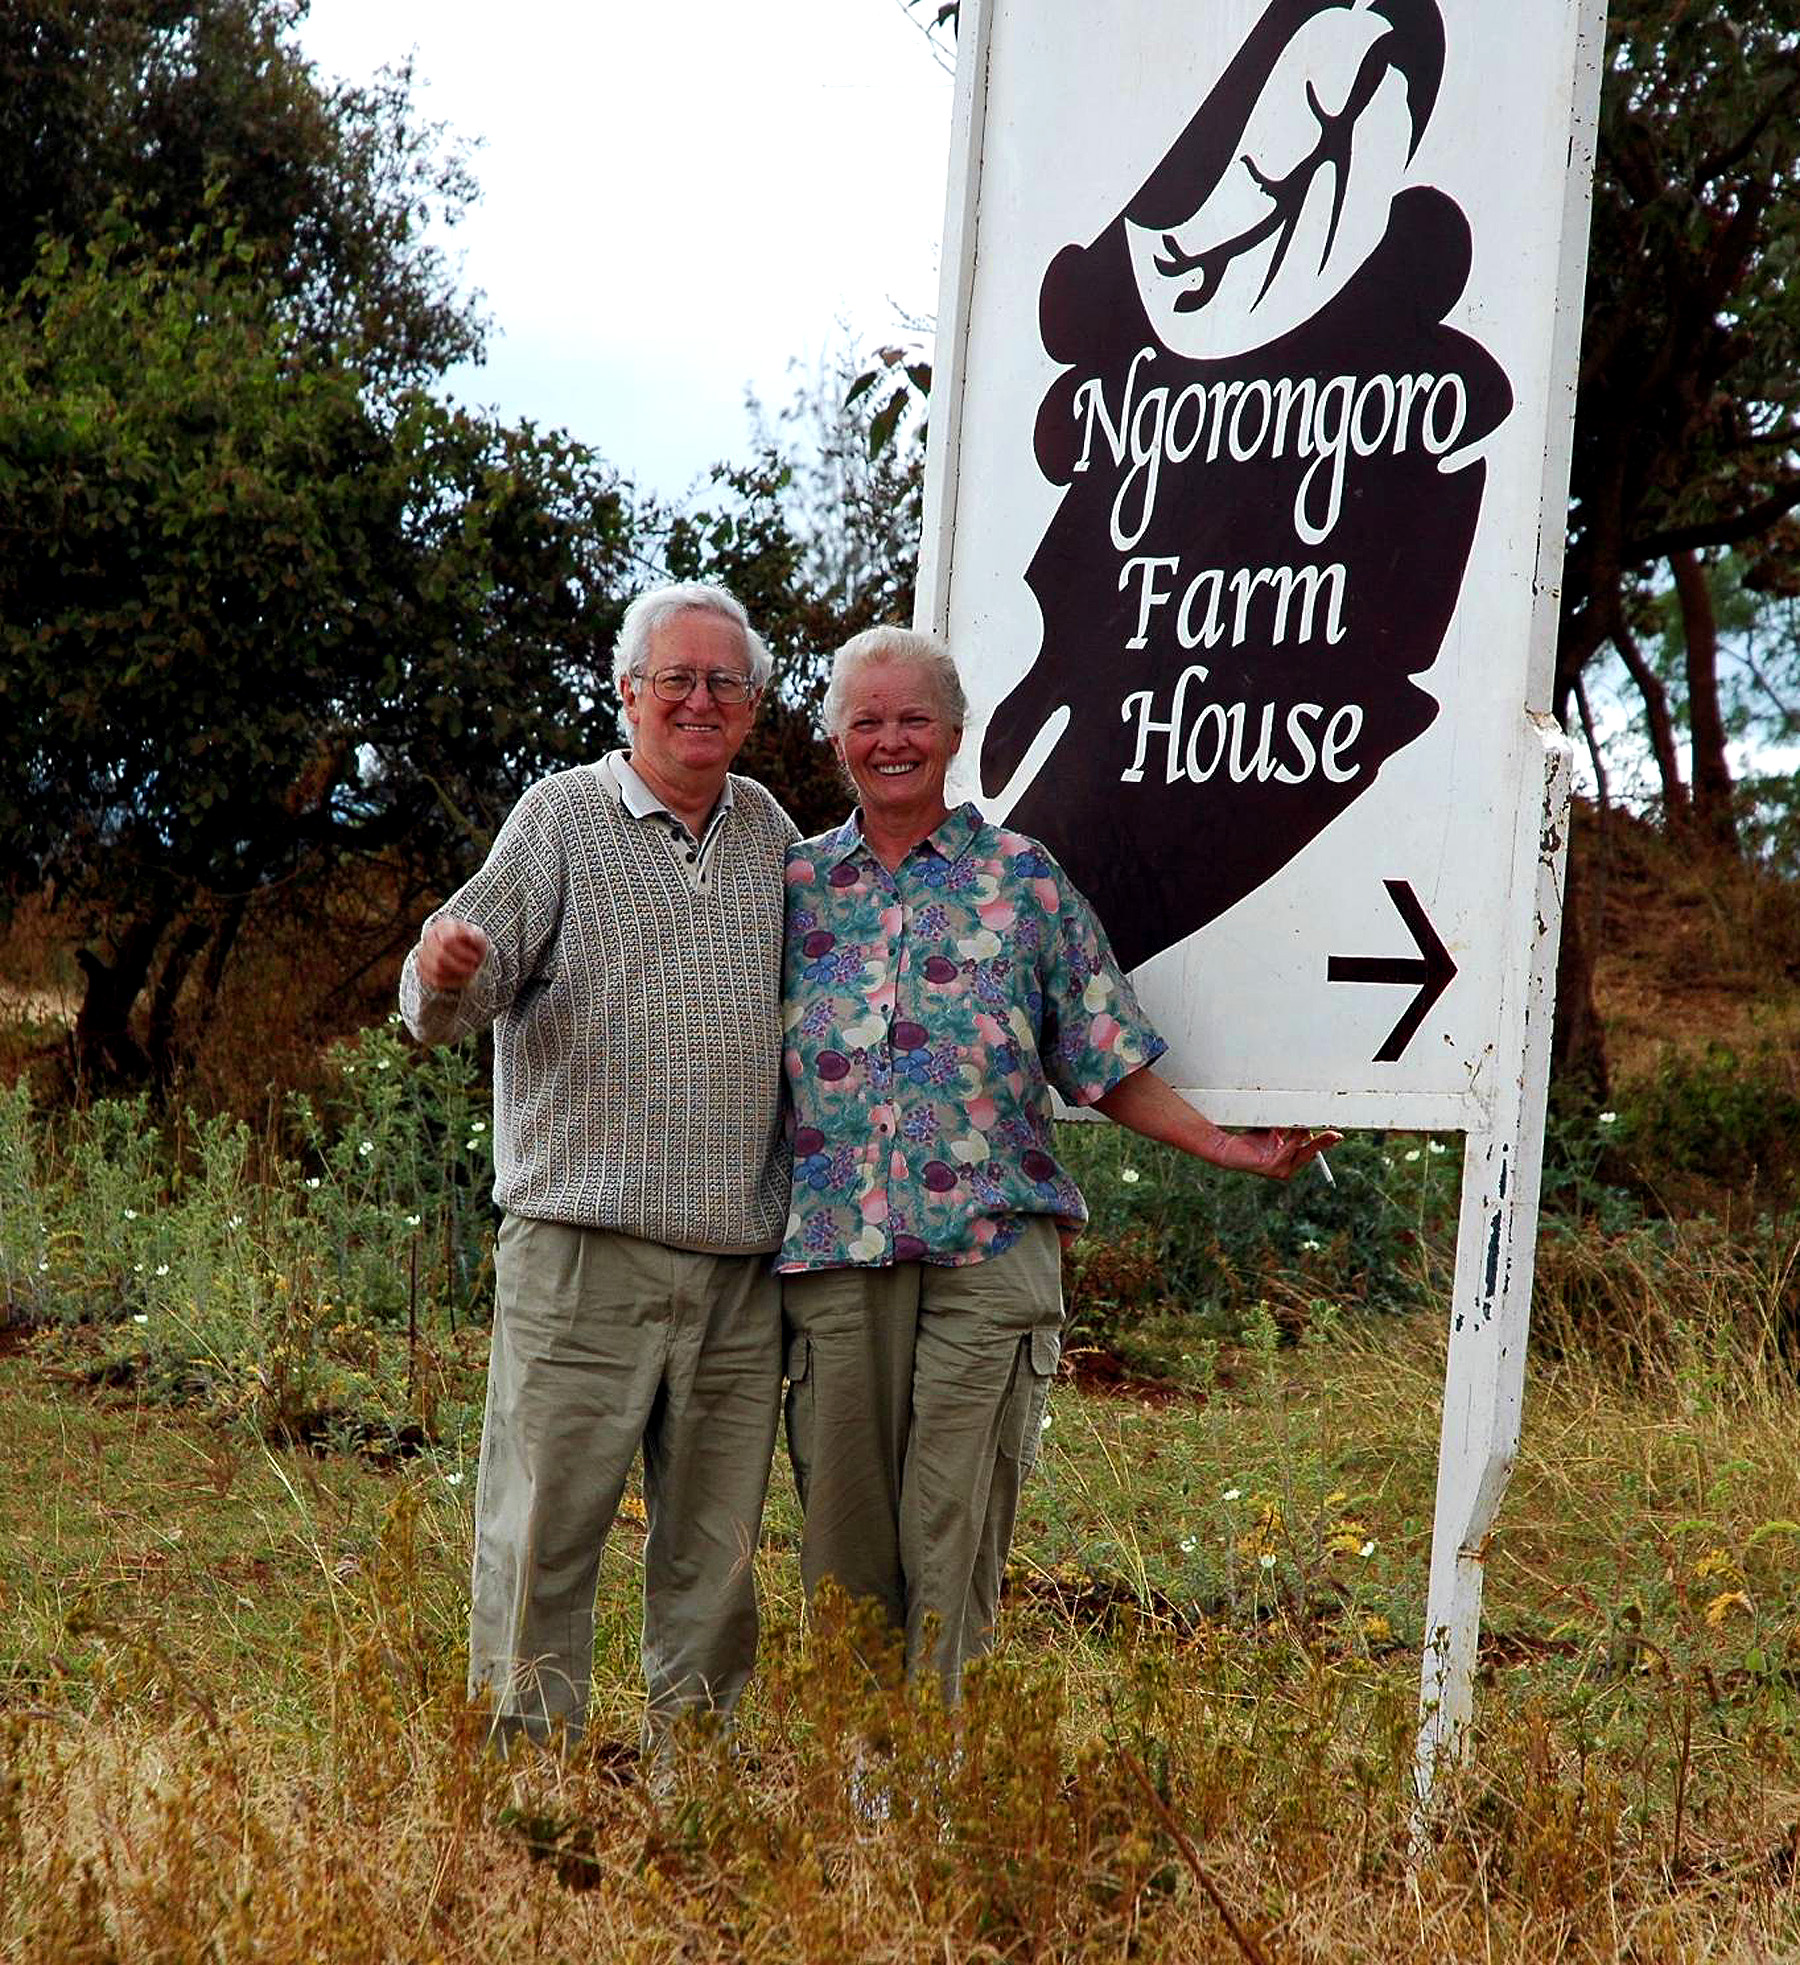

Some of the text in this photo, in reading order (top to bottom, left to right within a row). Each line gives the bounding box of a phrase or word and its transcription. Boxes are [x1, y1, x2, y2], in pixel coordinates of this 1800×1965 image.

[1072, 346, 1467, 552] Ngorongoro
[1118, 555, 1347, 650] Farm
[1120, 665, 1364, 785] House
